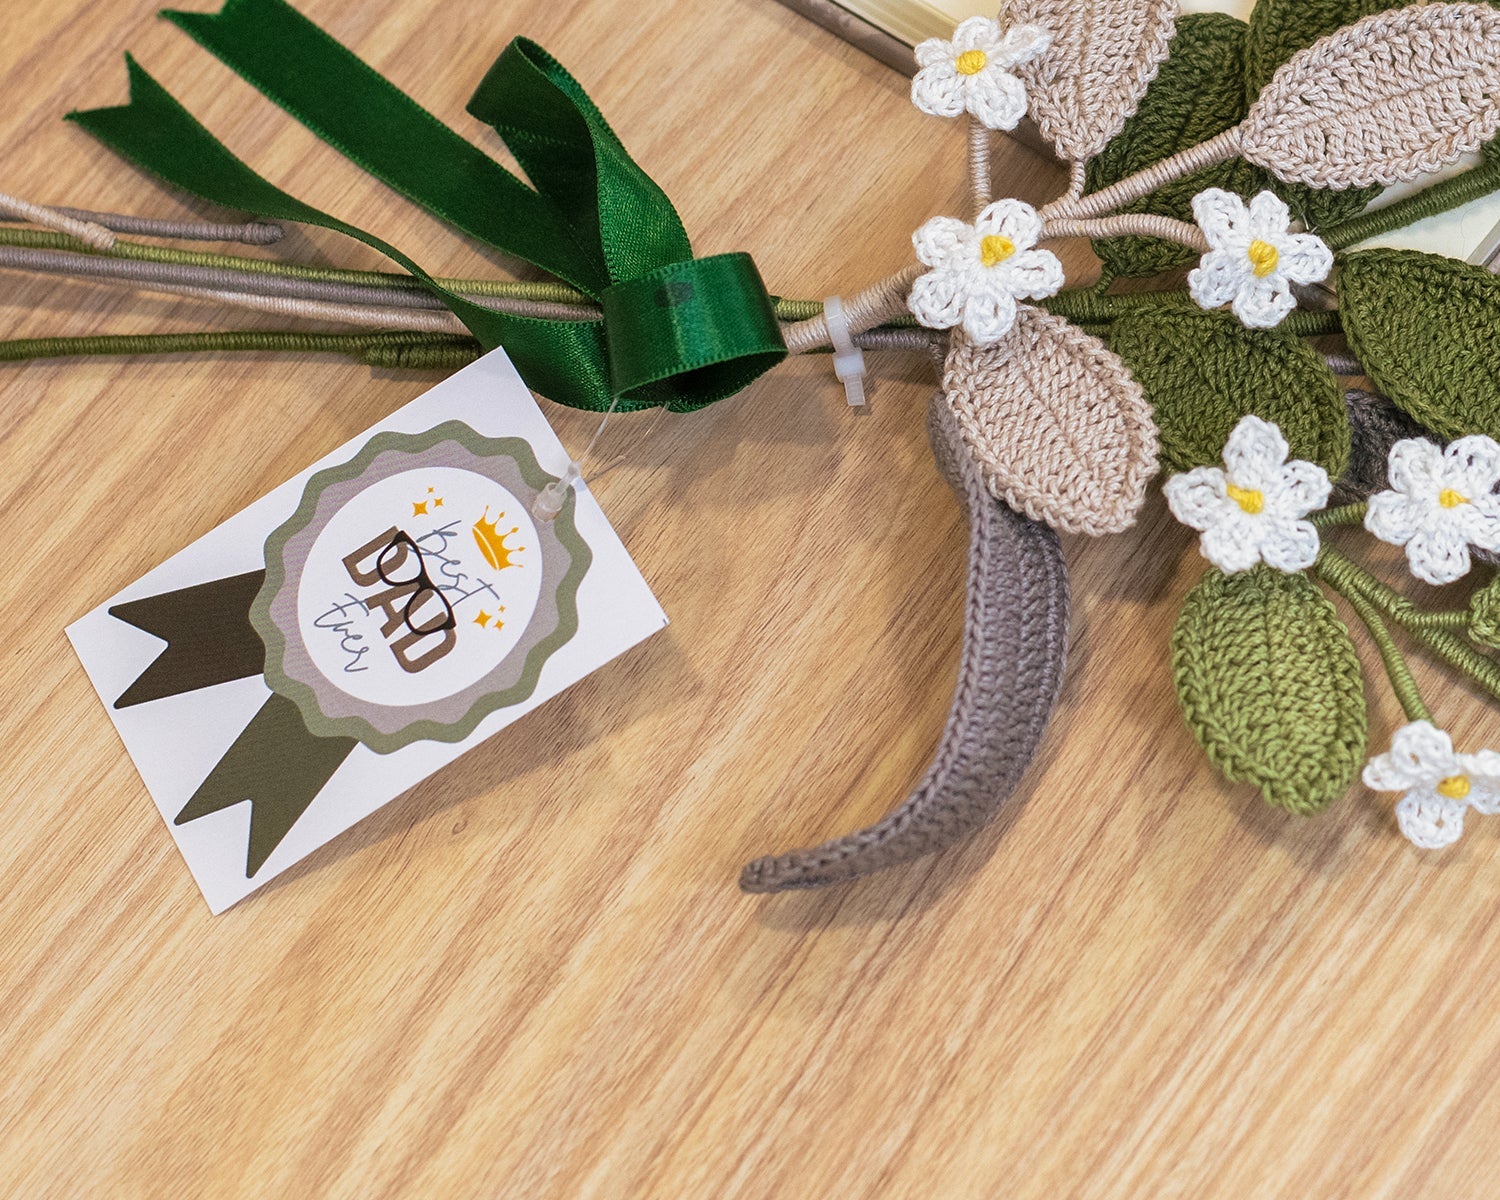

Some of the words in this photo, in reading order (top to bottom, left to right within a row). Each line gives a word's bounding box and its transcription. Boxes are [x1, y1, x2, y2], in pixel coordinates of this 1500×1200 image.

[341, 525, 457, 674] DAD
[406, 519, 500, 608] Best
[313, 592, 370, 673] Ever
